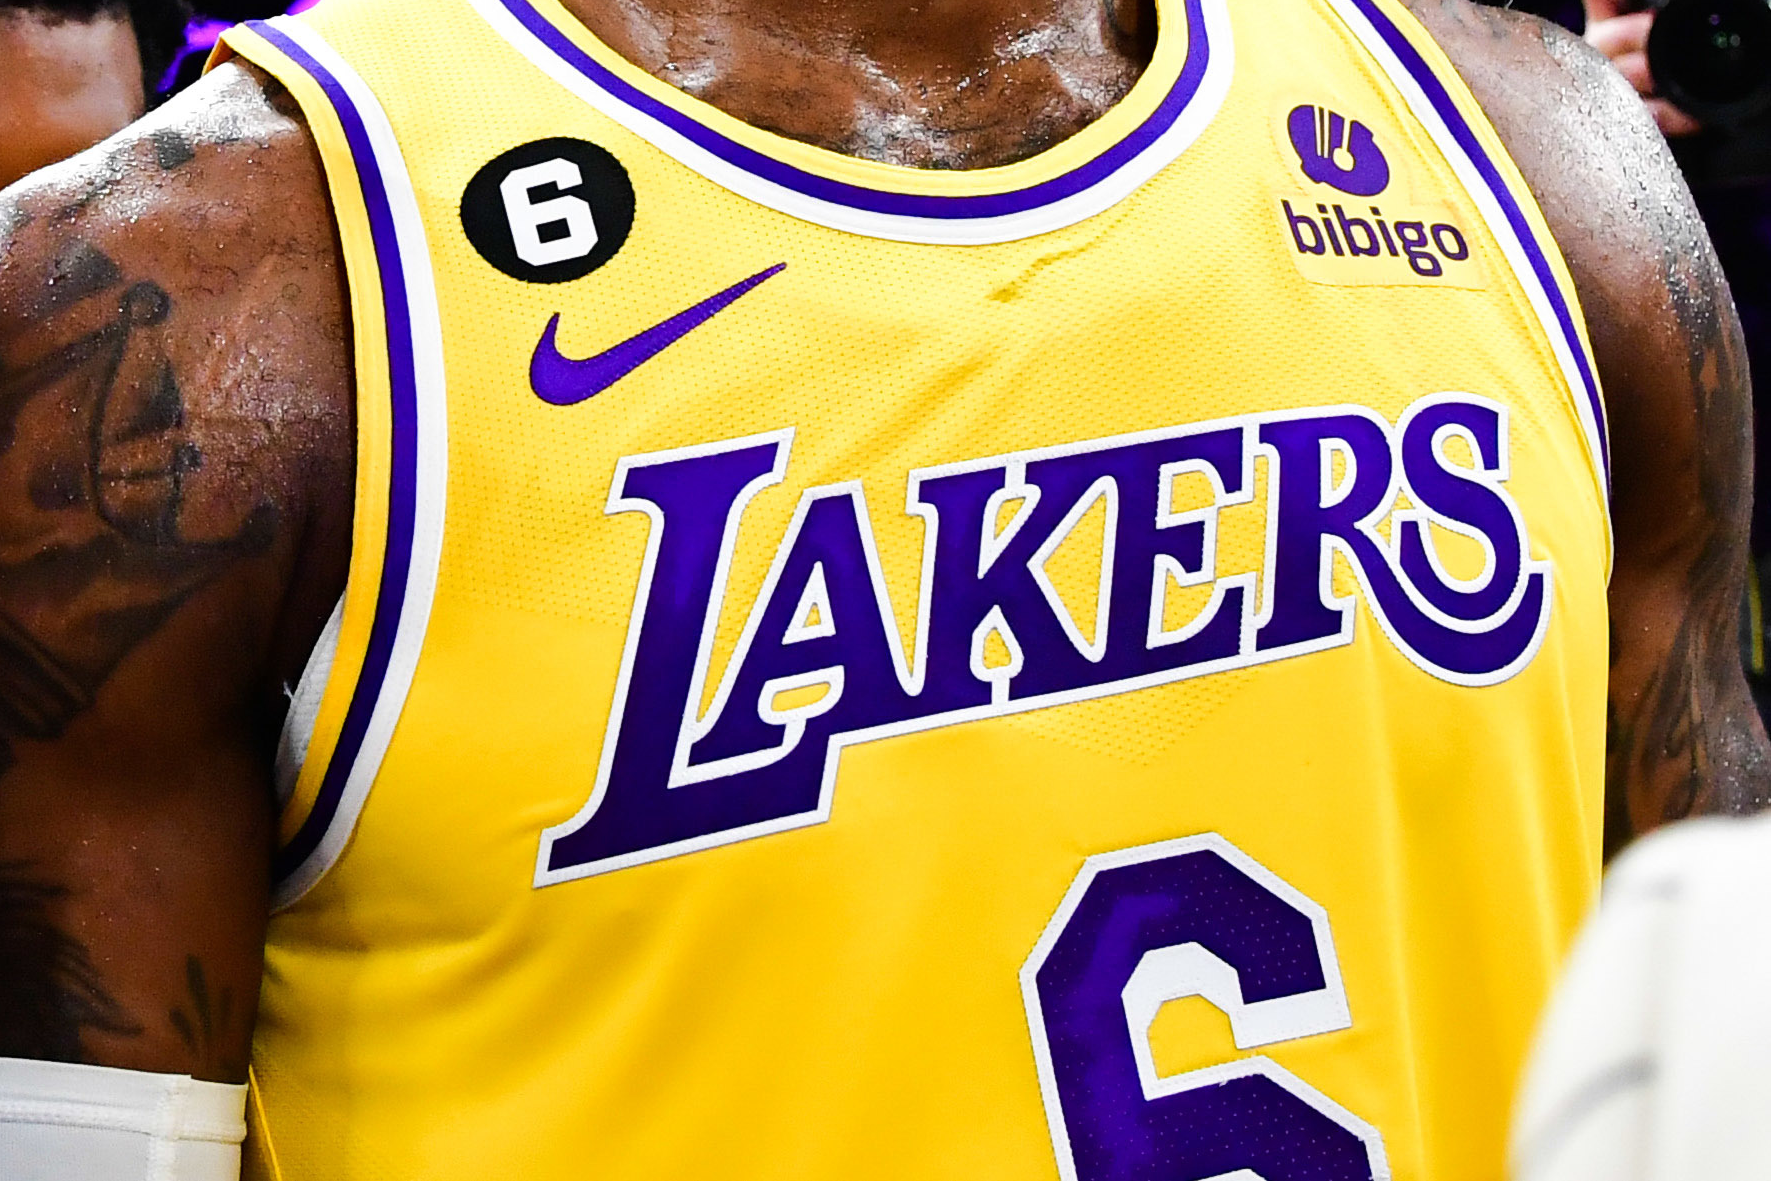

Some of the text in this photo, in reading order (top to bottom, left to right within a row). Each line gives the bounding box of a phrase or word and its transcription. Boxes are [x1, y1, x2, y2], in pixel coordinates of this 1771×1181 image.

[499, 157, 599, 267] 6
[1281, 199, 1470, 277] bibigo
[533, 392, 1551, 888] LAKERS
[1020, 832, 1389, 1181] 6
